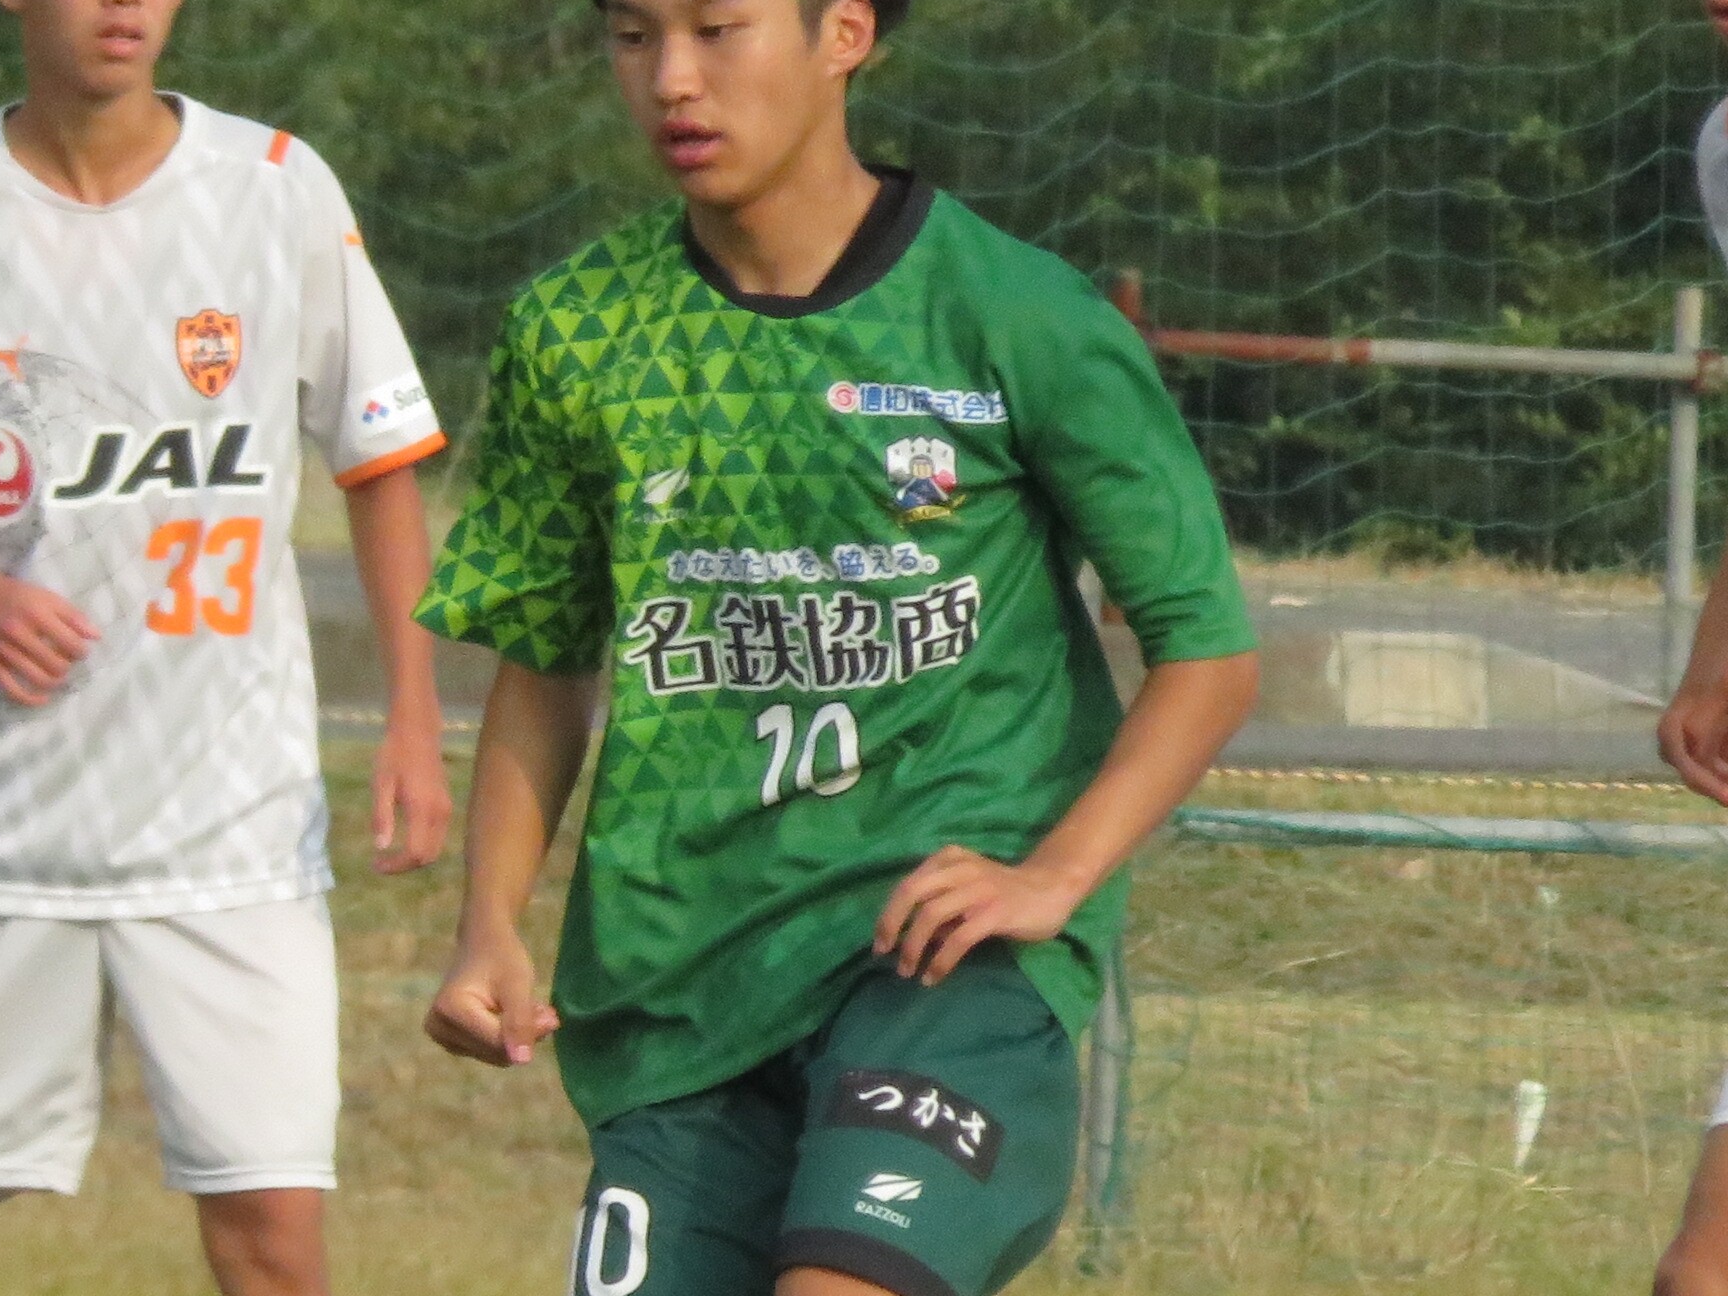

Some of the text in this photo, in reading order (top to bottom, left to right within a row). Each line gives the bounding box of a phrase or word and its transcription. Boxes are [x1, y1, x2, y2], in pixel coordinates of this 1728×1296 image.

[53, 424, 265, 501] JAL
[145, 516, 263, 636] 33
[626, 577, 980, 693] 名鉄協商
[756, 701, 862, 806] 10
[858, 1085, 987, 1158] つかさ
